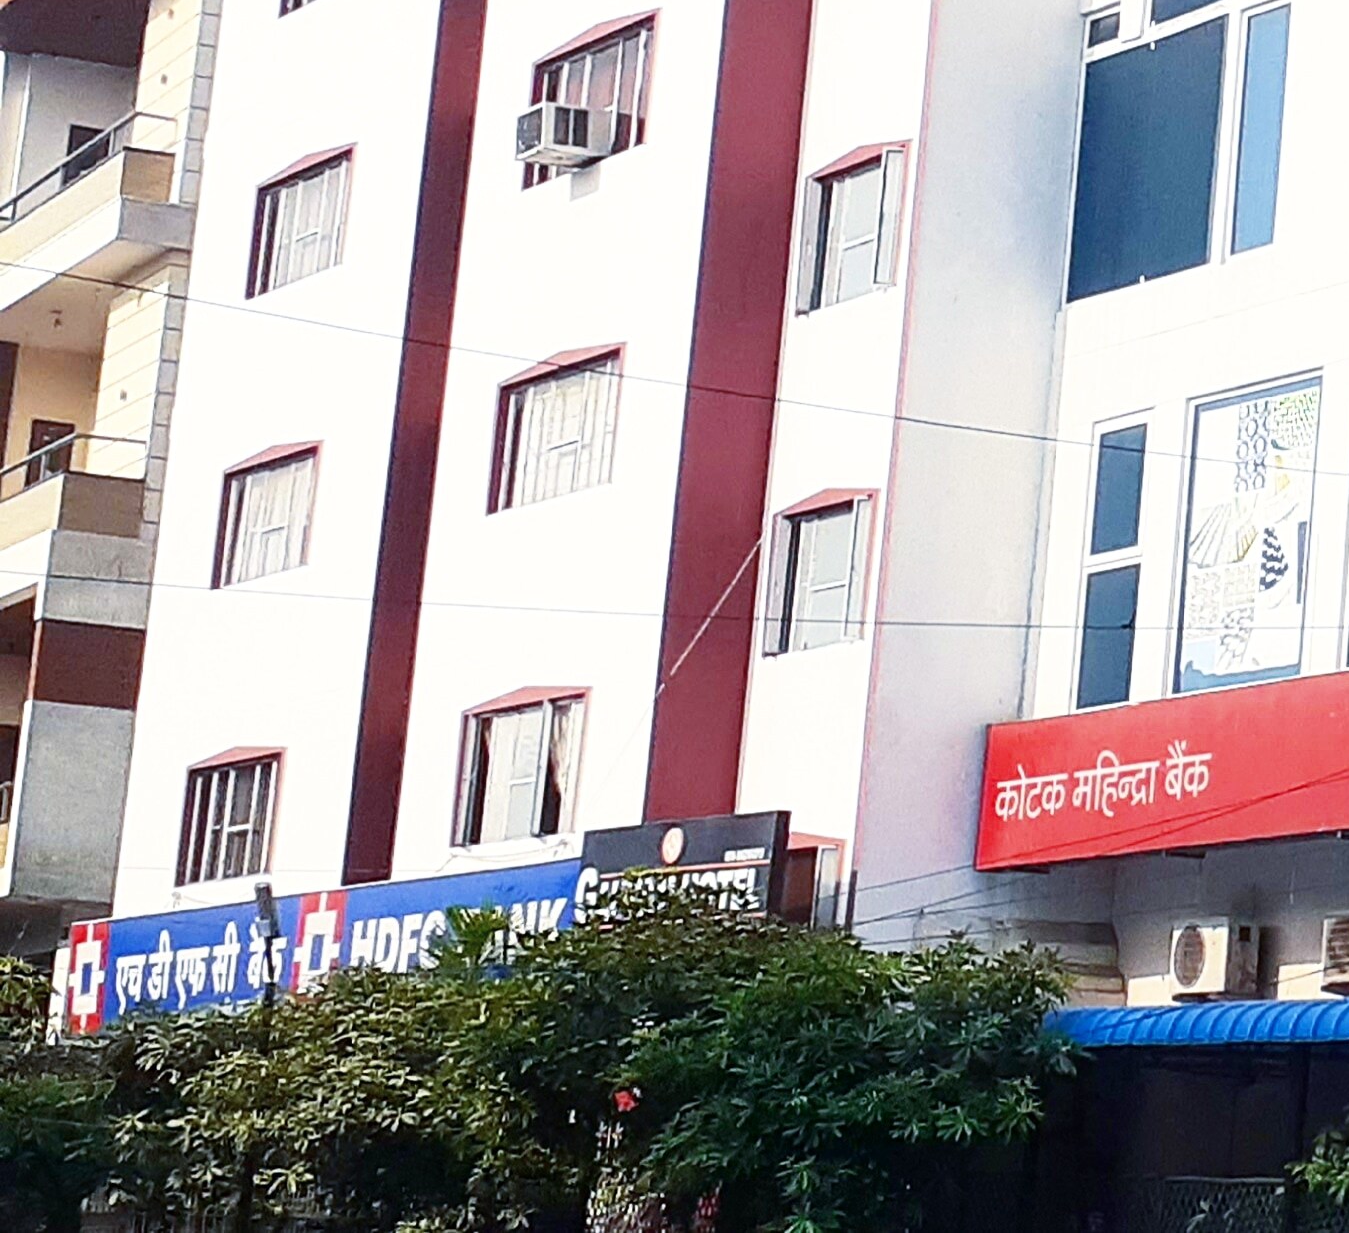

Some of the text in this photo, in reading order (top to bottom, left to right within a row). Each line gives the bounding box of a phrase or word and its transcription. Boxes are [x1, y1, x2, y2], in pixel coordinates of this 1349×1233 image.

[995, 739, 1212, 821] कोटक महिन्द्रा बैंक
[247, 916, 288, 989] बैक
[458, 897, 568, 966] ANK
